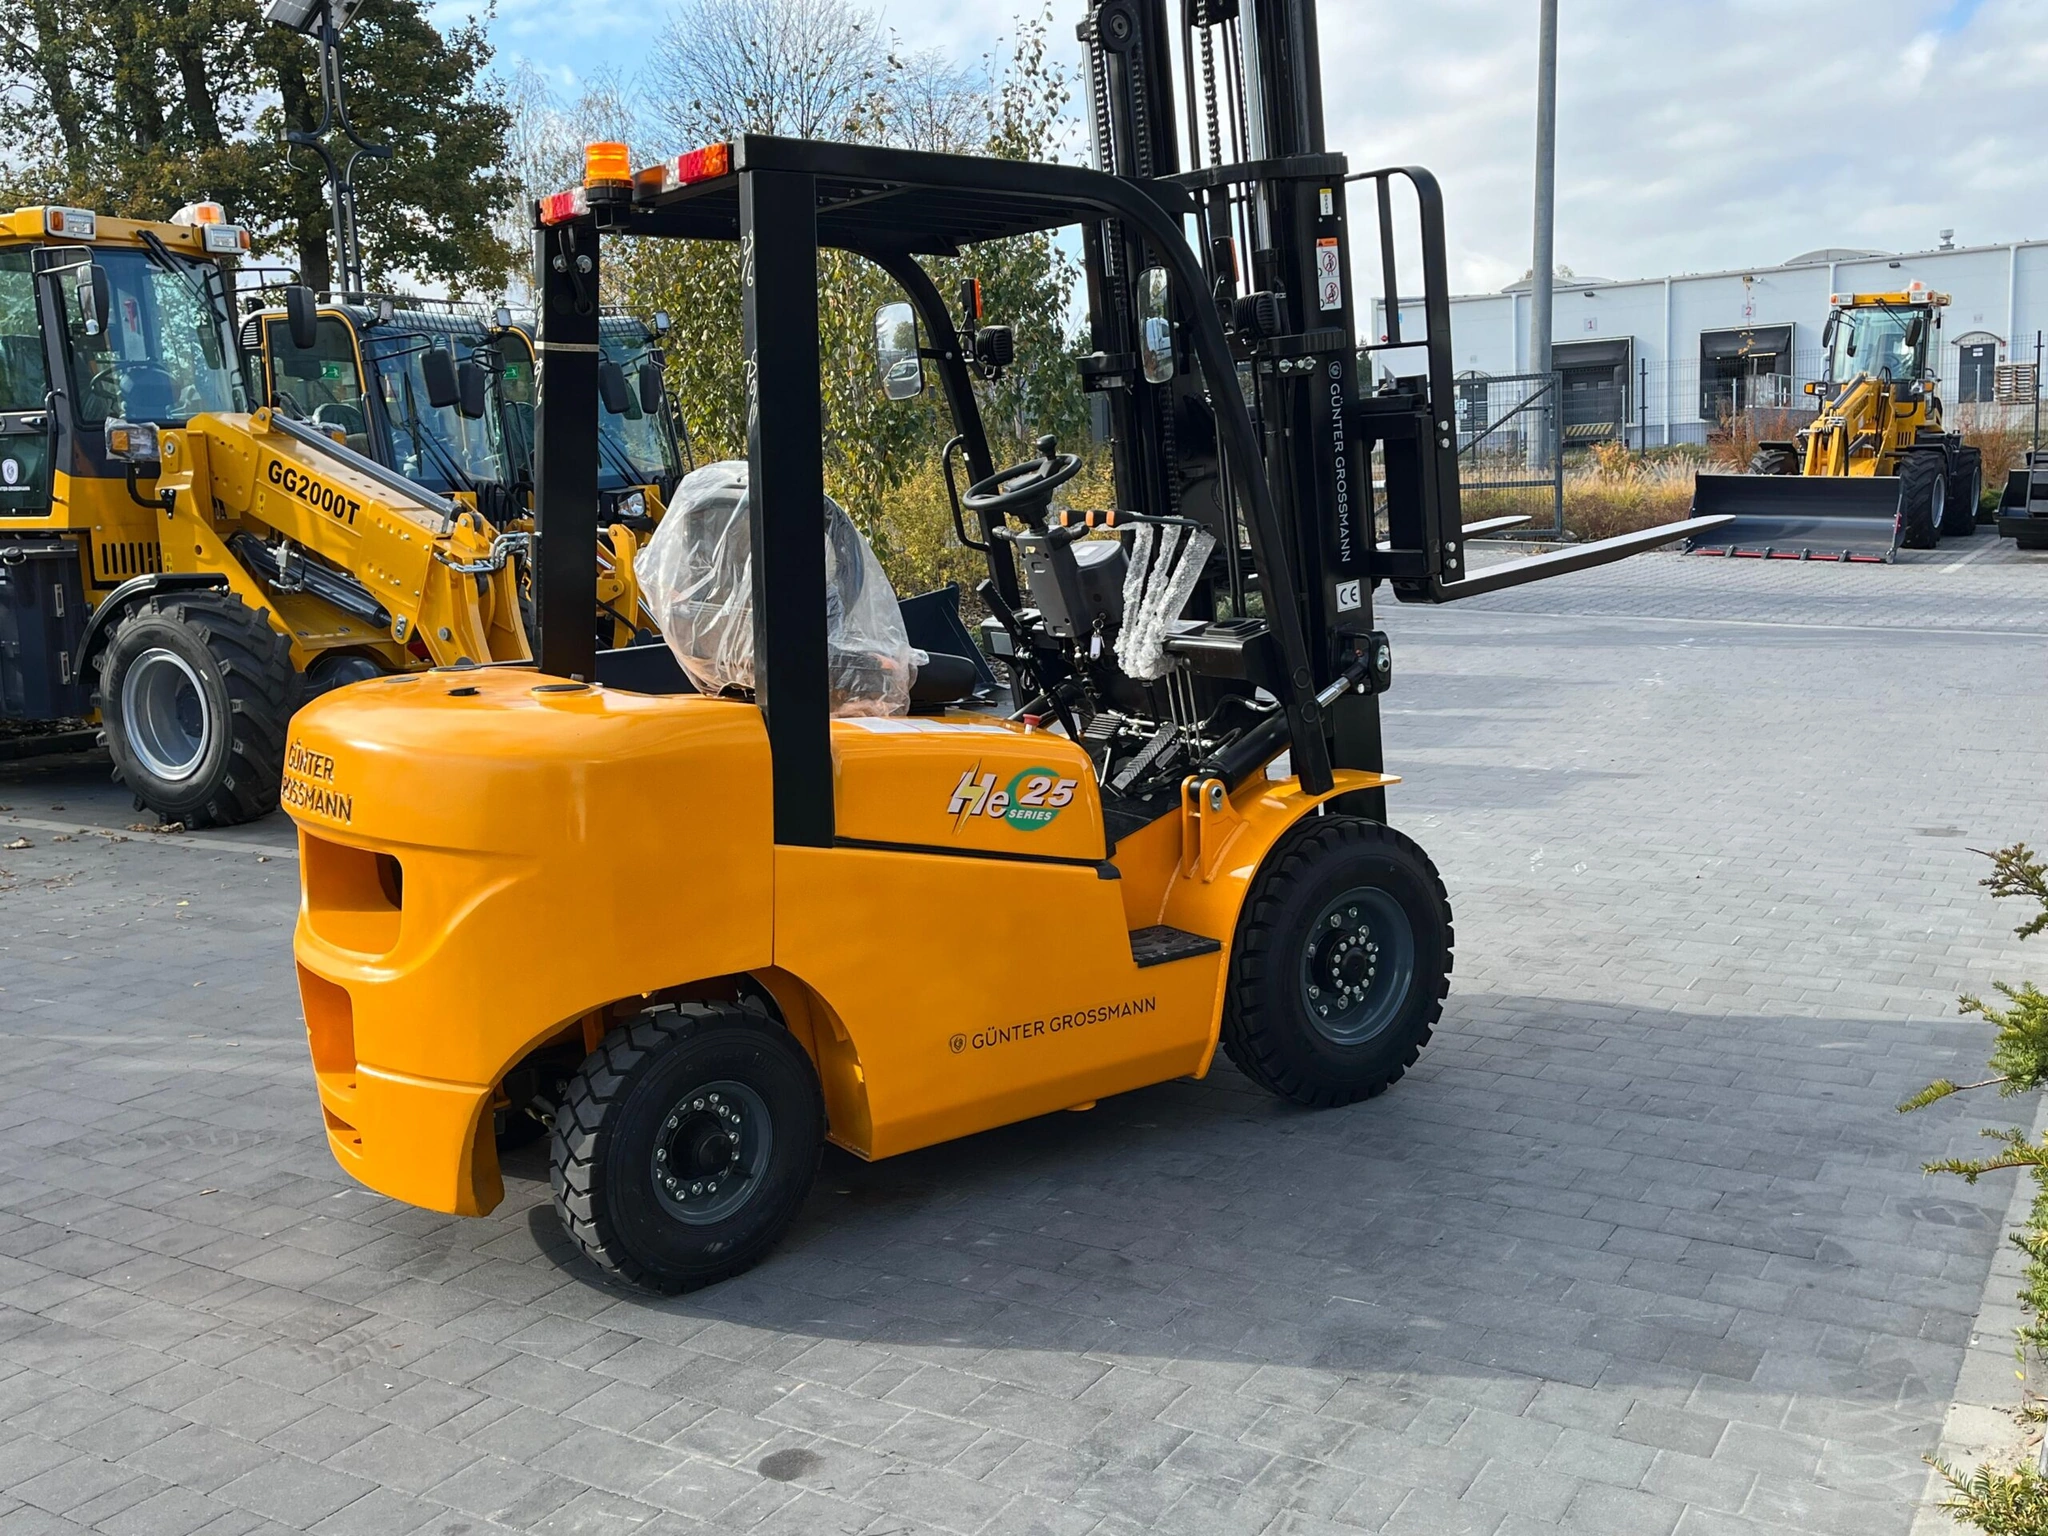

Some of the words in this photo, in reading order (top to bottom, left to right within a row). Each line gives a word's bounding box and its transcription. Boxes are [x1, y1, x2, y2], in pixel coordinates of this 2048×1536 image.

[1587, 320, 1594, 330] 1
[1745, 306, 1752, 316] 2
[1330, 383, 1344, 453] GÜNTER
[268, 459, 361, 526] GG2000T
[1335, 456, 1351, 563] GROSSMANN
[1339, 585, 1358, 605] CE
[281, 775, 353, 822] ROSSMANN
[1019, 776, 1078, 807] 25
[1008, 809, 1053, 821] SERIES
[972, 1020, 1045, 1049] GÜNTER
[1049, 997, 1156, 1032] GROSSMANN
